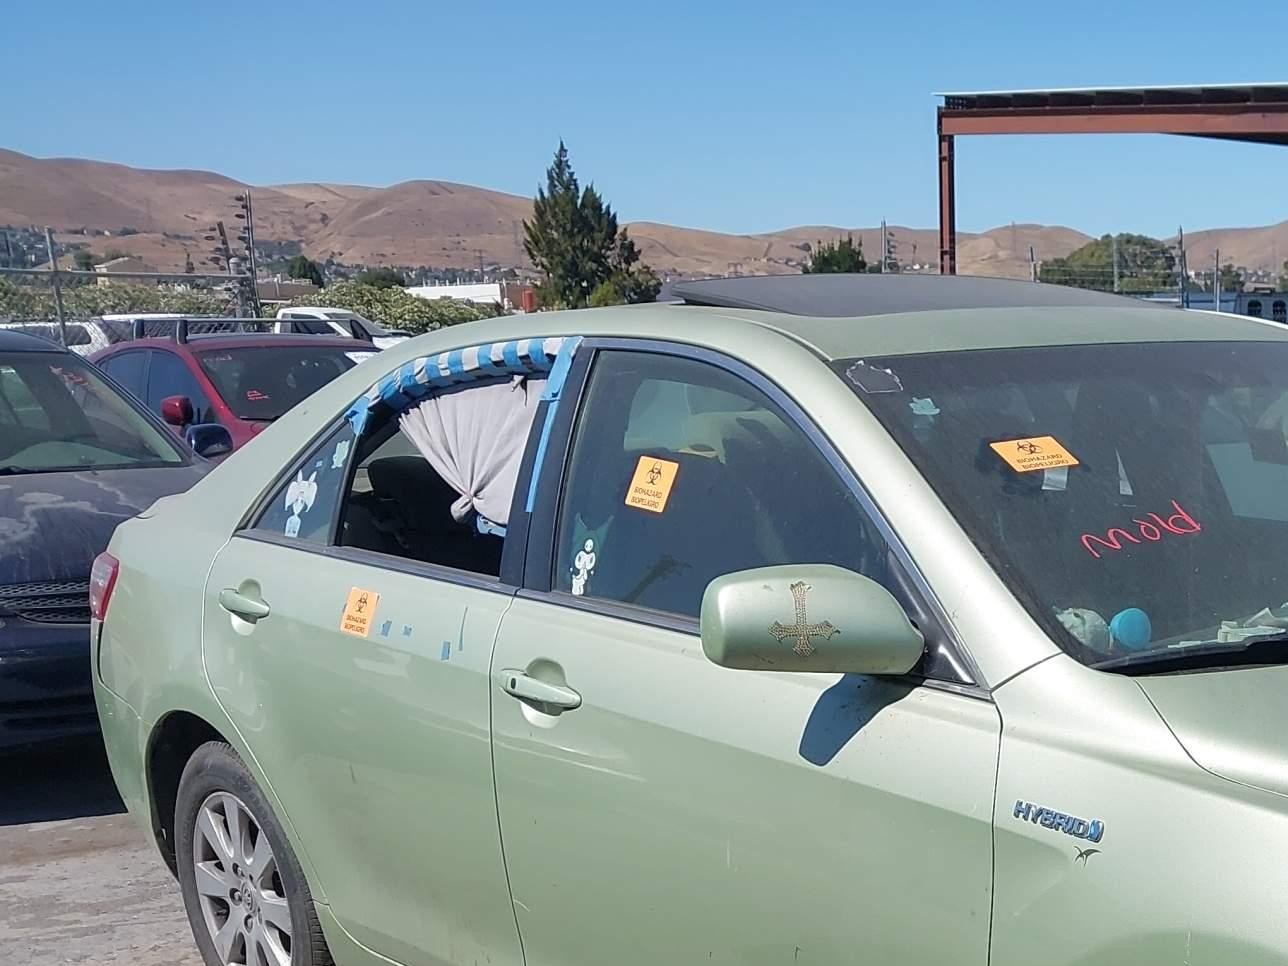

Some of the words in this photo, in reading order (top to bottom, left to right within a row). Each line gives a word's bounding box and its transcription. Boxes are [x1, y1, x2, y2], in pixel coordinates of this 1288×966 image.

[1016, 454, 1062, 463] BIOHAZARD
[634, 486, 662, 498] BIOHAZARD
[1013, 799, 1090, 840] HYBRID
